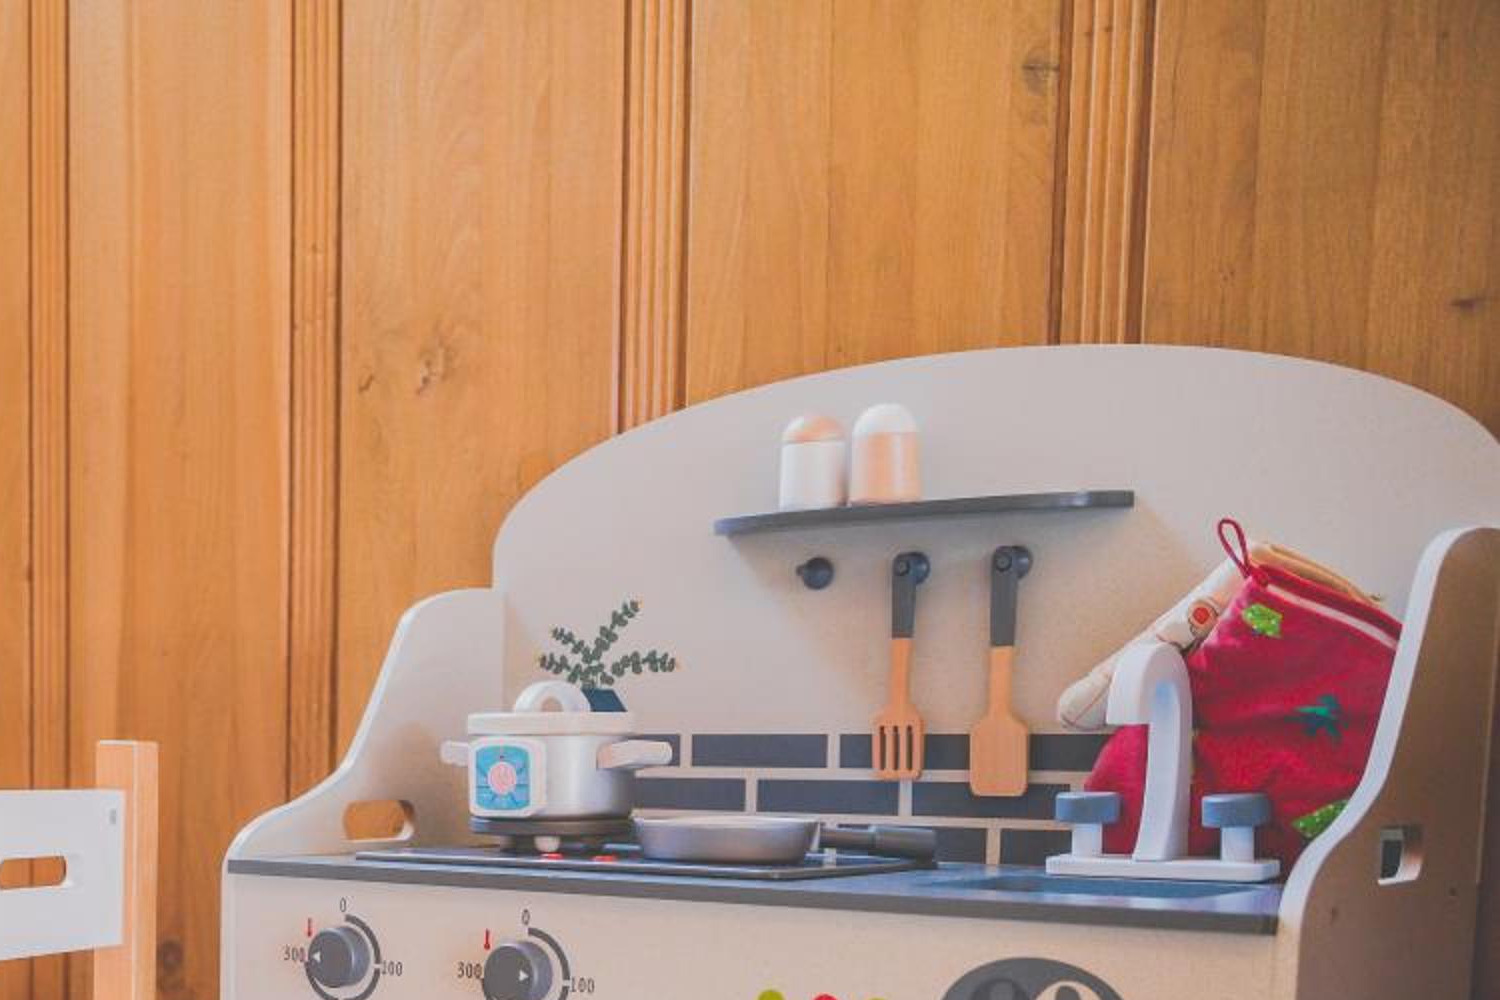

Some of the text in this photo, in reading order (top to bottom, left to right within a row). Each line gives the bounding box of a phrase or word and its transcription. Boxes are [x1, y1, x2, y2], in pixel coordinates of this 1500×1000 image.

[340, 897, 347, 913] 0
[521, 908, 531, 926] 0
[283, 944, 306, 963] 300
[381, 960, 403, 977] 100
[457, 961, 483, 979] 300
[570, 977, 595, 993] 100
